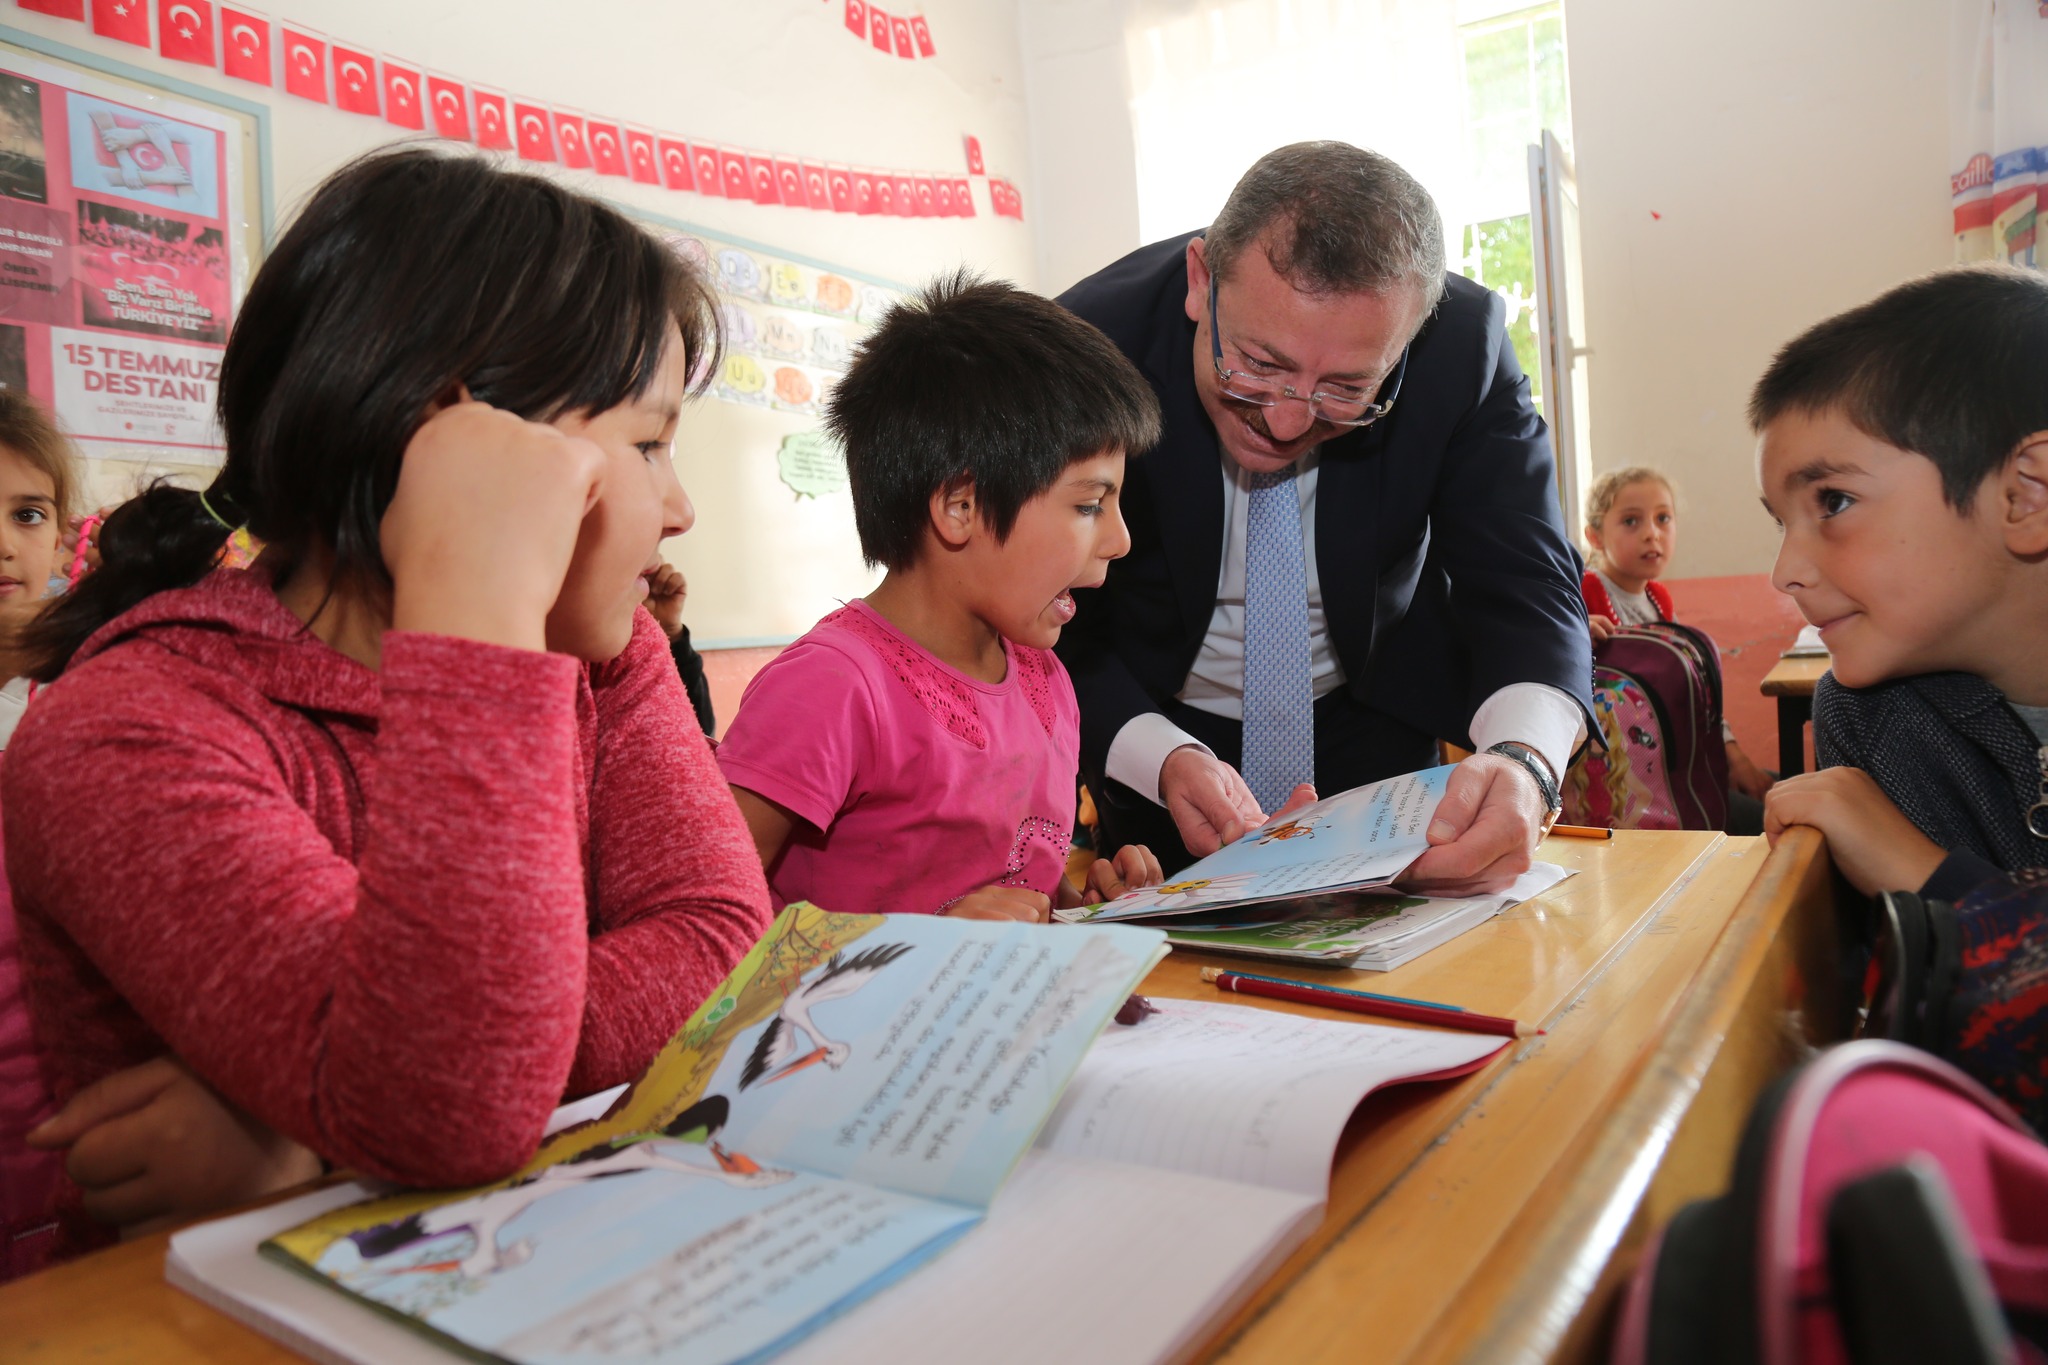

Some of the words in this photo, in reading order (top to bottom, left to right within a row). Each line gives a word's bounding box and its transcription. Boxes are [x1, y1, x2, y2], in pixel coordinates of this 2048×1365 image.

[147, 283, 173, 298] Ben
[174, 287, 198, 303] Yok
[164, 299, 212, 318] Birlikte
[63, 343, 95, 366] 15
[98, 347, 221, 381] TEMMUZ
[84, 370, 206, 403] DESTANI
[956, 989, 990, 1028] annesi
[993, 1002, 1013, 1020] bir
[917, 1027, 935, 1045] da
[956, 1037, 1013, 1111] gelmesiyle
[923, 1117, 965, 1162] leylek
